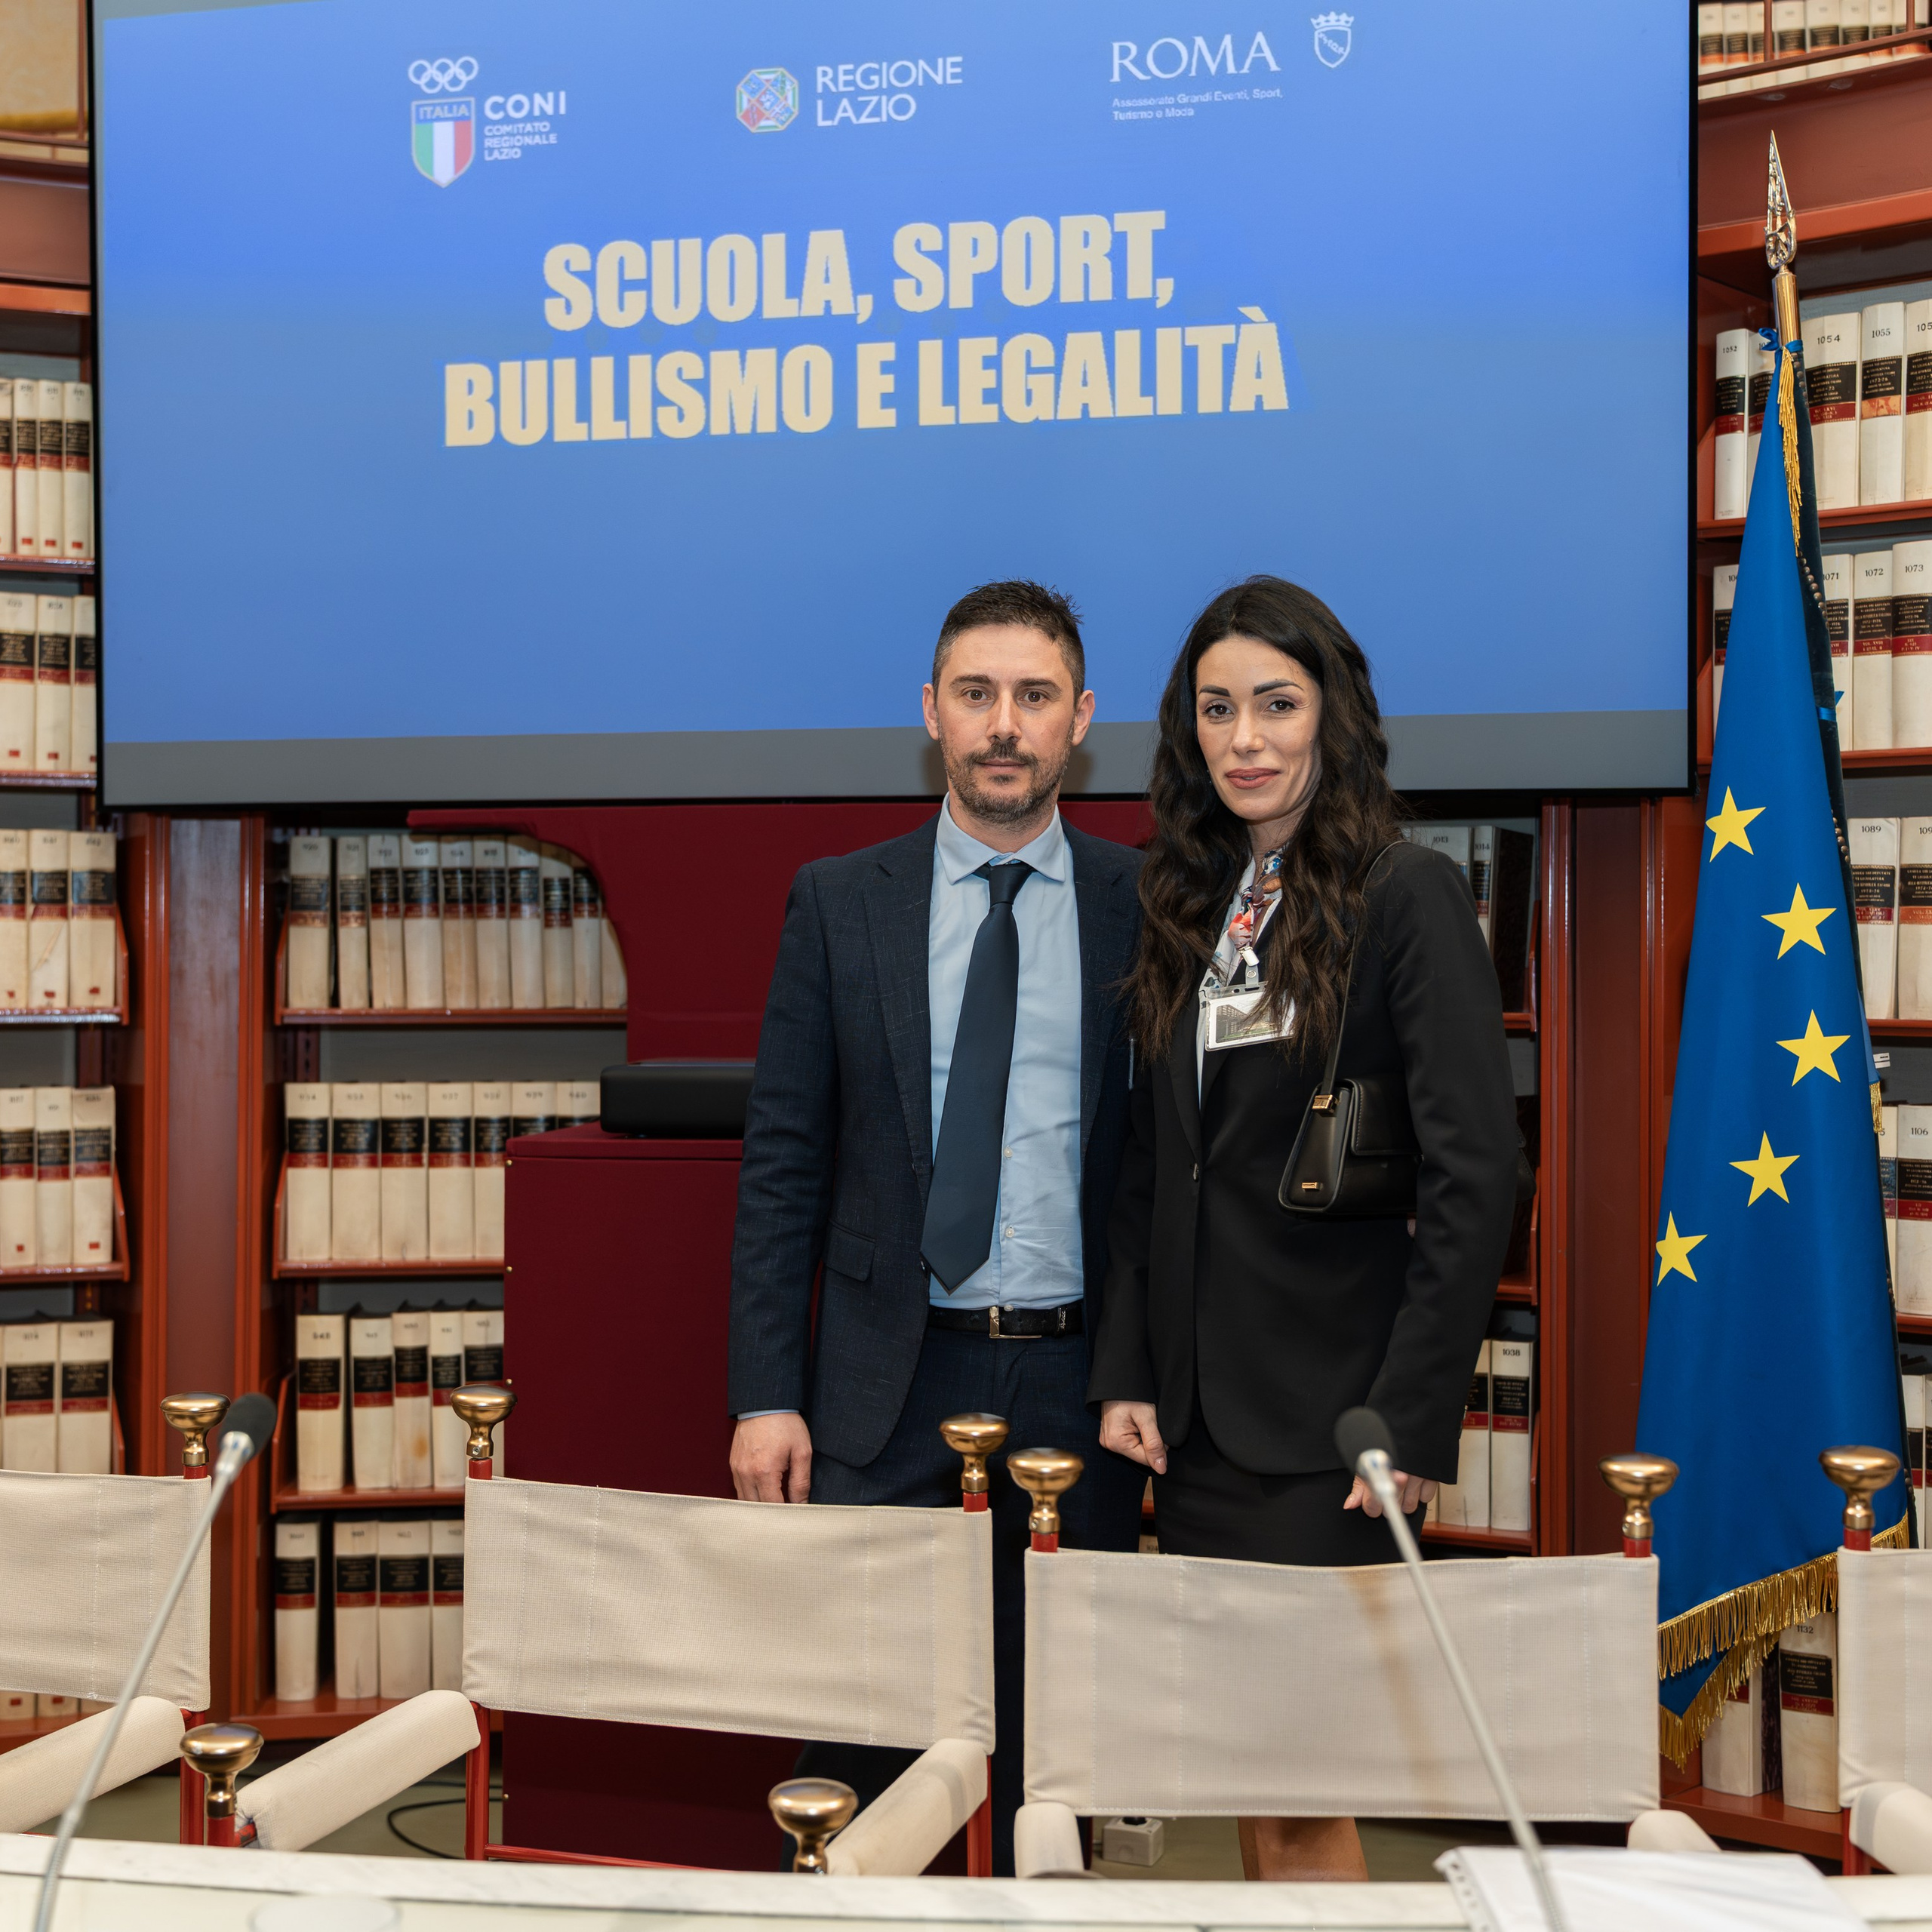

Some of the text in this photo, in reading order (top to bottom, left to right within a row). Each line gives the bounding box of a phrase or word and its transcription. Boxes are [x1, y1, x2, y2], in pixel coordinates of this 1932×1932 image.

[1109, 31, 1281, 82] ROMA
[816, 56, 963, 94] REGIONE
[1112, 95, 1175, 108] Assessorato
[1177, 91, 1212, 104] Grandi
[1252, 88, 1283, 100] Sport,
[419, 104, 469, 119] ITALIA
[484, 91, 566, 121] CONI
[817, 94, 917, 127] LAZIO
[1112, 106, 1194, 121] Turismo e Moda
[484, 122, 550, 136] COMITATO
[484, 134, 558, 148] REGIONALE
[484, 148, 522, 161] LAZIO
[542, 210, 1174, 331] SCUOLA, SPORT,
[1917, 321, 1932, 332] 105
[1872, 328, 1890, 338] 1055
[1817, 334, 1840, 345] 1054
[444, 306, 1289, 447] BULLISMO E LEGALITÀ
[1865, 568, 1884, 577] 1072
[1905, 565, 1924, 573] 1073
[1728, 574, 1738, 583] 10
[1823, 572, 1839, 581] 1071
[1862, 825, 1881, 833] 1089
[1919, 826, 1932, 835] 109
[1911, 1128, 1928, 1136] 1106
[1503, 1348, 1521, 1357] 1038
[1796, 1625, 1814, 1635] 1132
